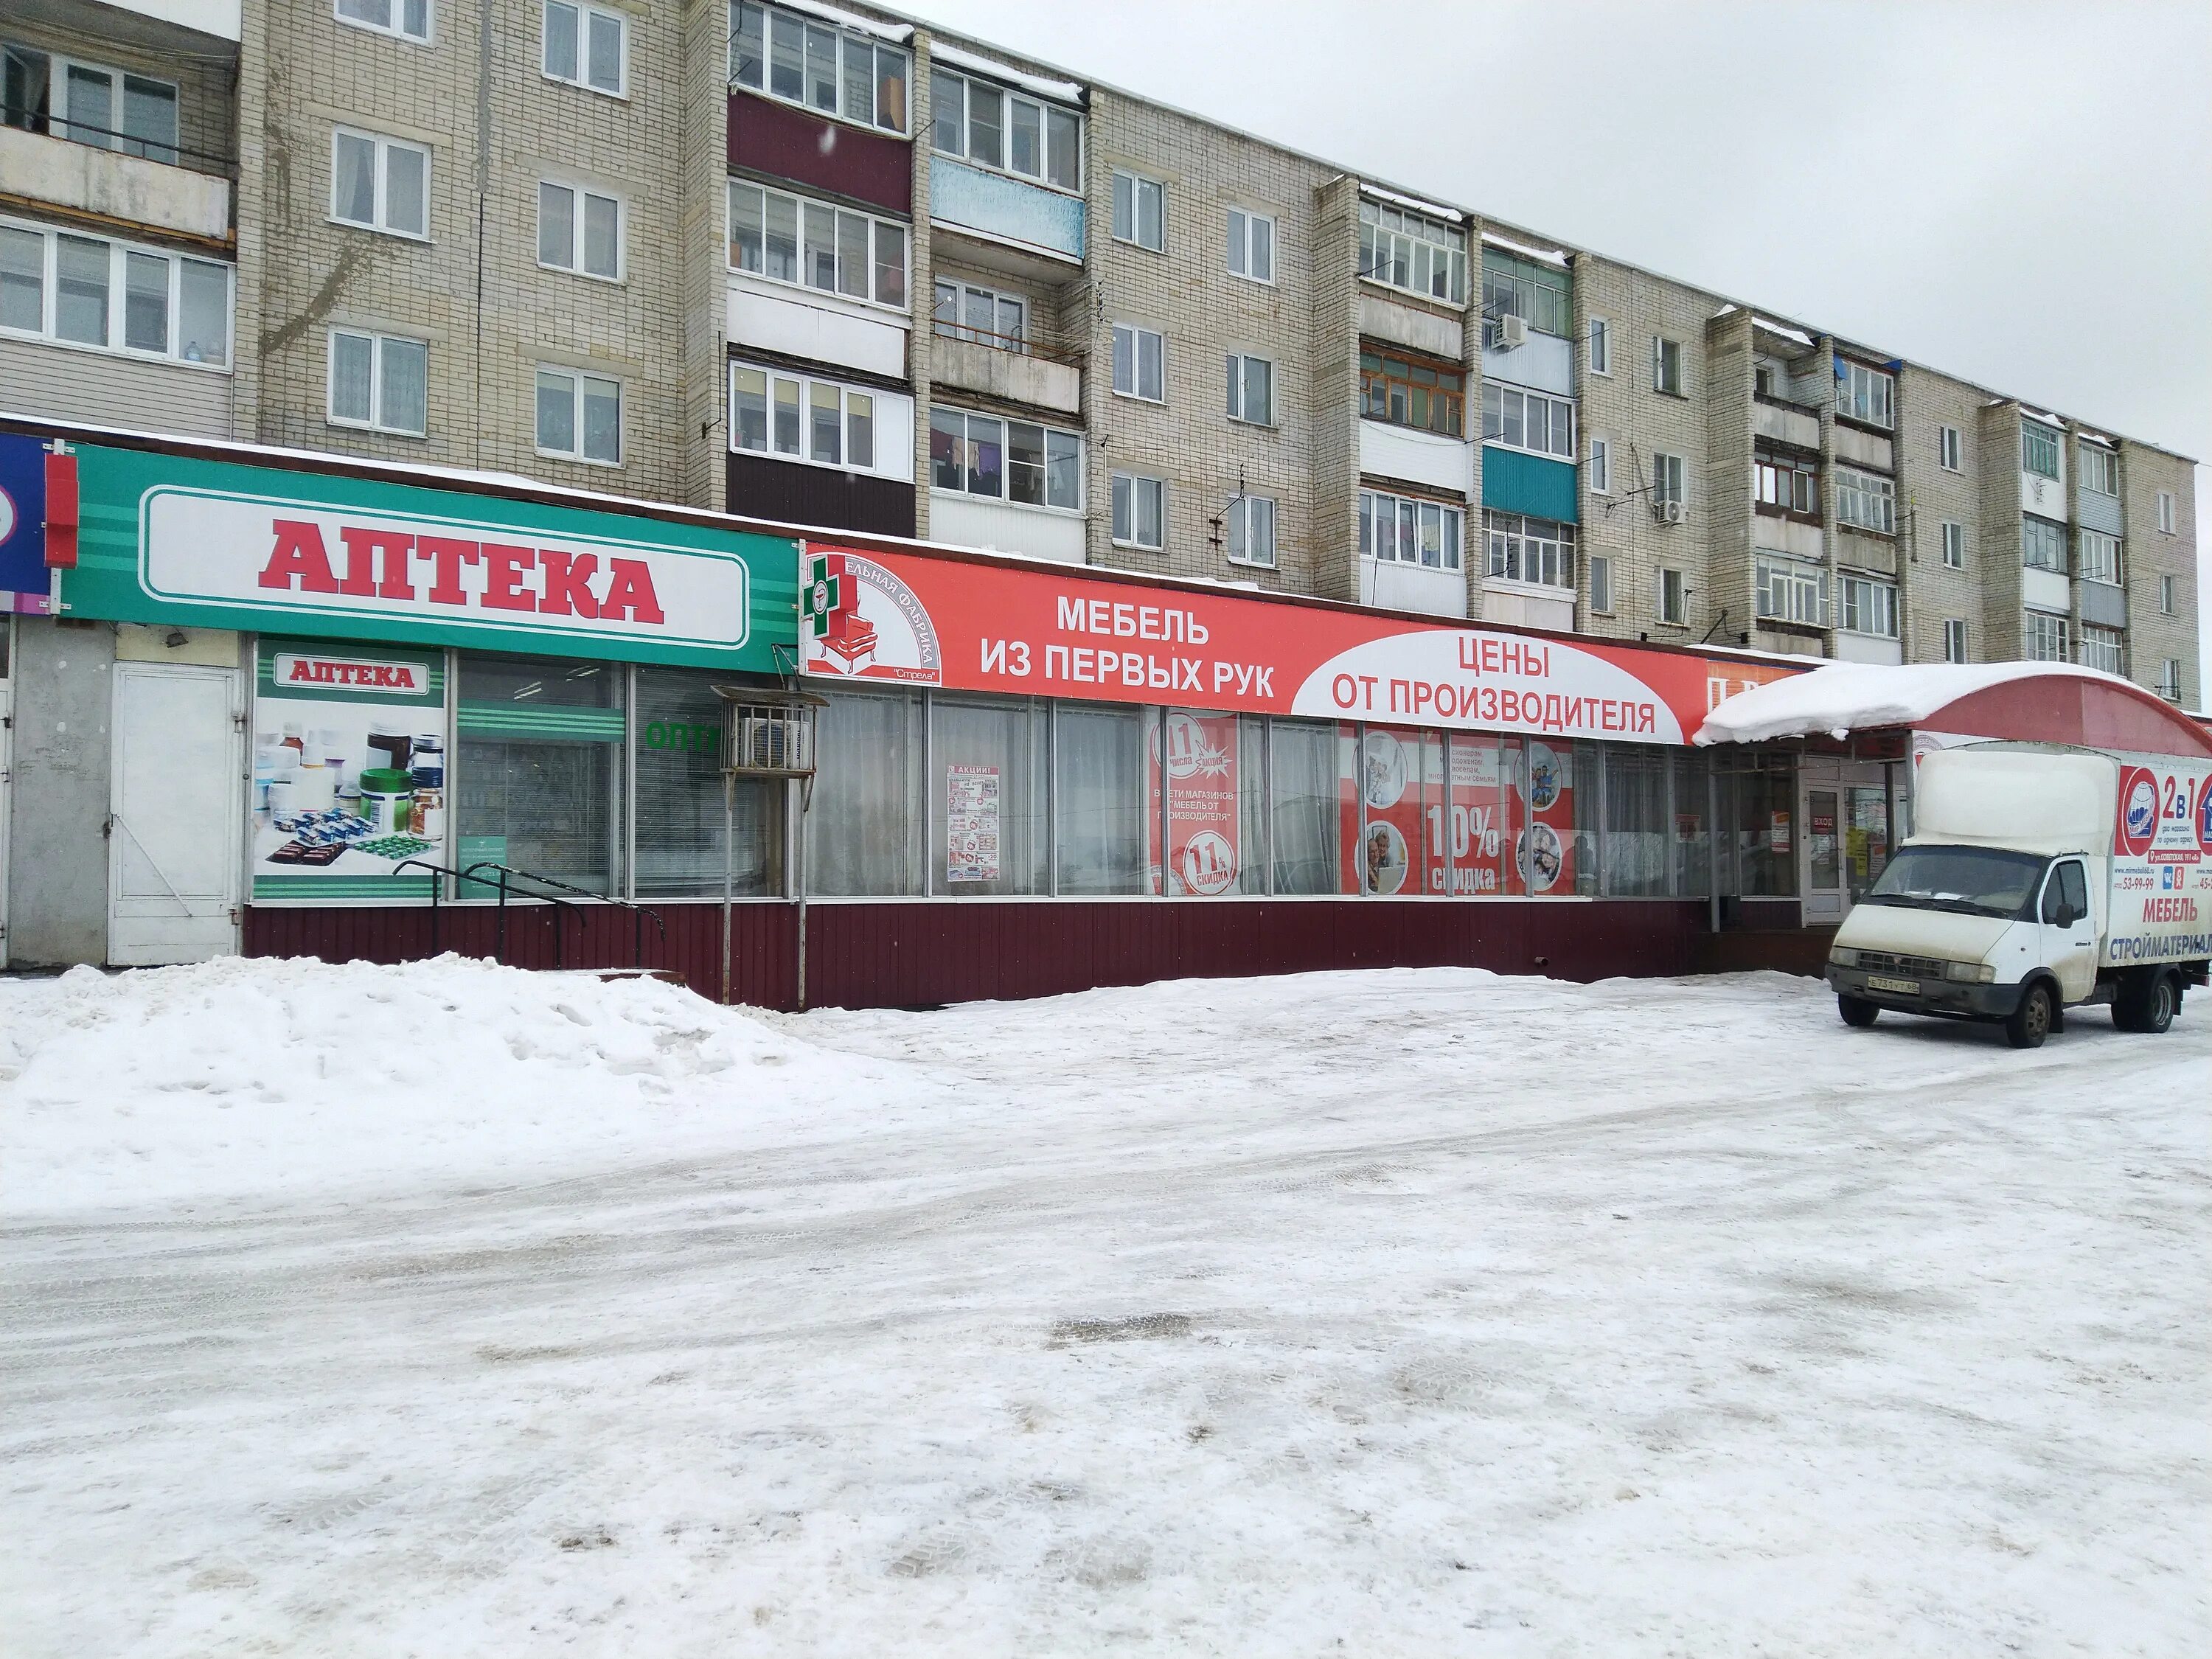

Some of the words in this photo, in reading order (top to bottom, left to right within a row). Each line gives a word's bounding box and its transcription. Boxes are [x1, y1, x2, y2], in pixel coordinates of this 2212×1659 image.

[258, 518, 665, 625] АПТЕКА
[844, 561, 899, 594] ЕЛЬНАЯ
[898, 592, 933, 664] ФАБРИКА
[1057, 595, 1209, 645] МЕБЕЛЬ
[1458, 636, 1550, 678] ЦЕНЫ
[289, 660, 415, 688] АПТЕКА
[894, 669, 936, 680] "Стрела"
[980, 638, 1032, 677] ИЗ
[1045, 644, 1204, 692] ПЕРВЫХ
[1213, 661, 1275, 698] РУК
[1332, 673, 1379, 710] ОТ
[1390, 678, 1656, 734] ПРОИЗВОДИТЕЛЯ
[1440, 746, 1484, 757] сионерам,
[1202, 757, 1223, 768] АКЦИЯ
[1440, 757, 1484, 767] одоженам,
[958, 767, 990, 775] АКЦИИ!
[1451, 766, 1481, 774] воселам,
[1167, 790, 1184, 798] ЕТИ
[1186, 790, 1234, 801] МАГАЗИНОВ
[1208, 801, 1220, 810] ОТ
[1157, 811, 1231, 821] ОИЗВОДИТЕЛЯ"
[1814, 817, 1833, 828] ВХОД
[1427, 804, 1499, 858] 10%
[1197, 870, 1229, 886] СКИДКА
[1432, 867, 1495, 895] сидка
[2123, 877, 2154, 891] 53-99-99
[2142, 897, 2198, 923] МЕБЕЛЬ
